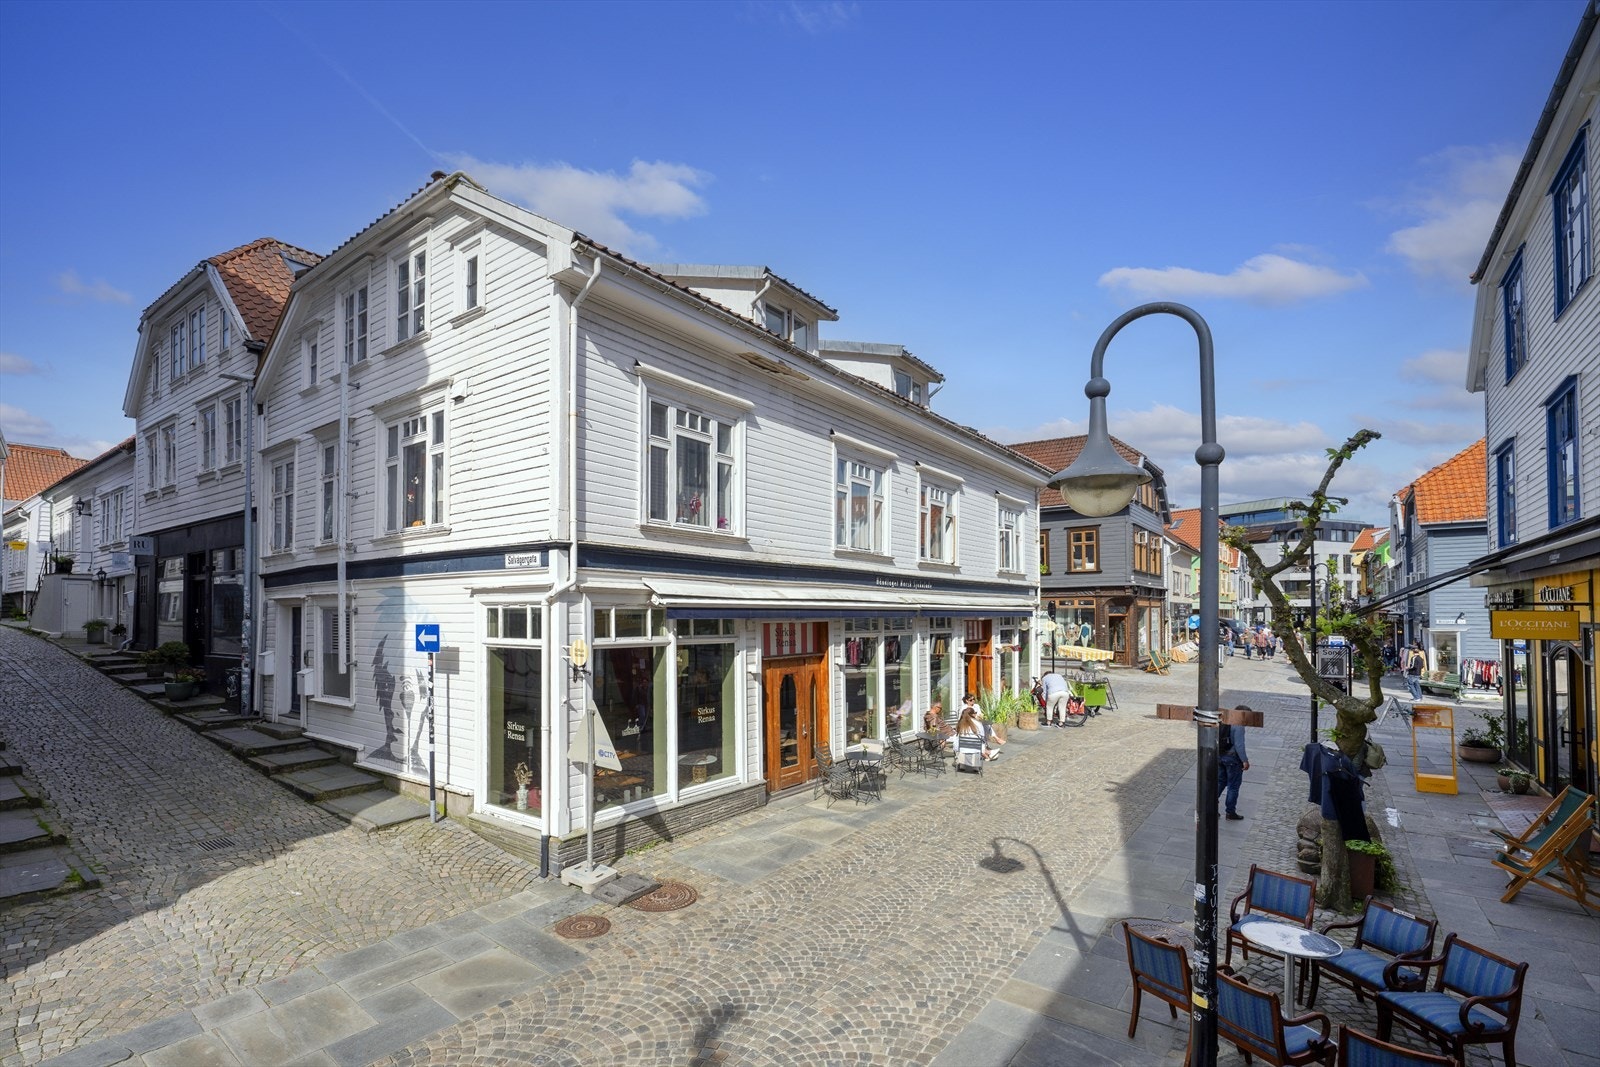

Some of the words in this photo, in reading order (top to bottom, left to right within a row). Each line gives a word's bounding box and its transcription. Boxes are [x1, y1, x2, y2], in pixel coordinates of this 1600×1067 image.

[1500, 619, 1570, 628] L'OCCITANE
[697, 706, 716, 716] Sirkus
[507, 720, 525, 732] Sirkus
[507, 730, 526, 742] Renaa
